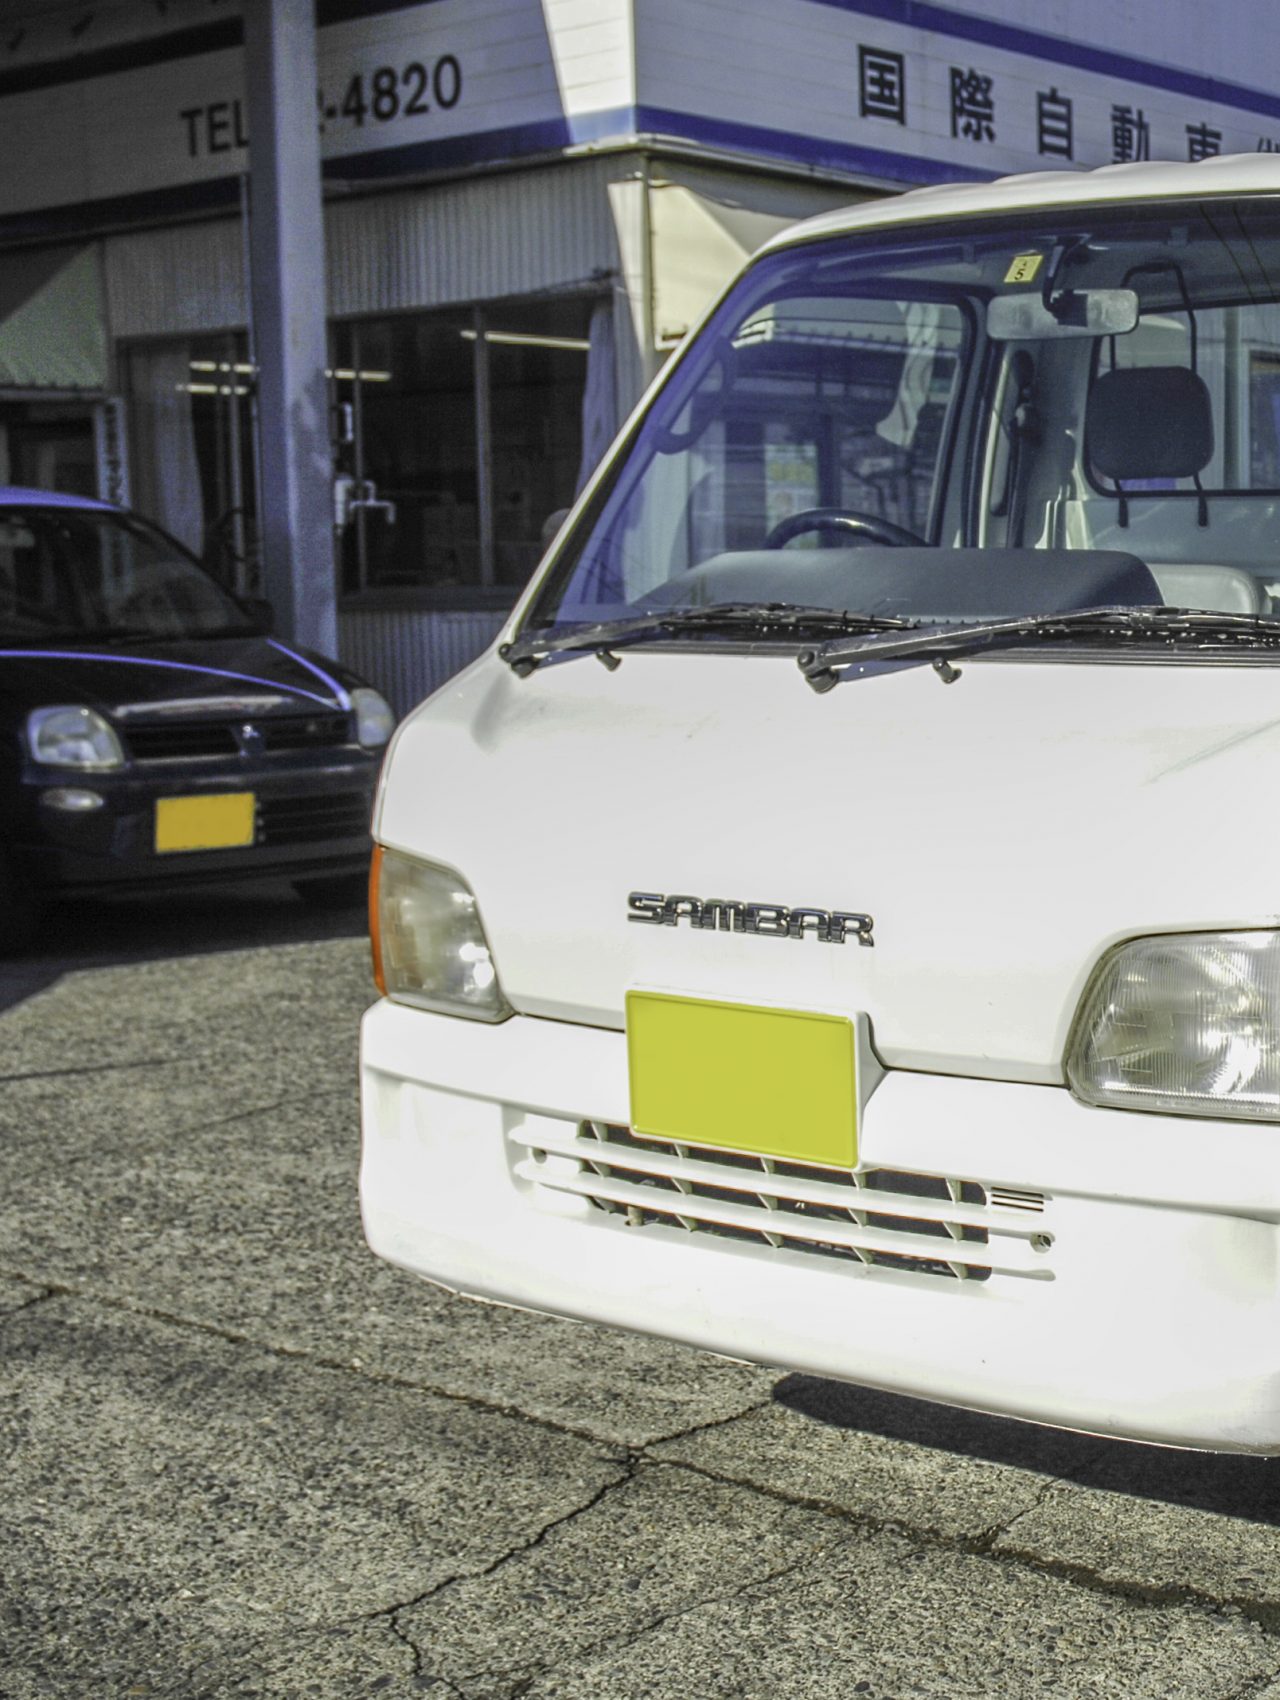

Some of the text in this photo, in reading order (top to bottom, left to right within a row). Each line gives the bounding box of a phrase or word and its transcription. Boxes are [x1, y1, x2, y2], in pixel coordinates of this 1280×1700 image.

[180, 54, 462, 157] TEL -4820
[1014, 268, 1026, 280] 5
[627, 891, 875, 947] SAMBAR
